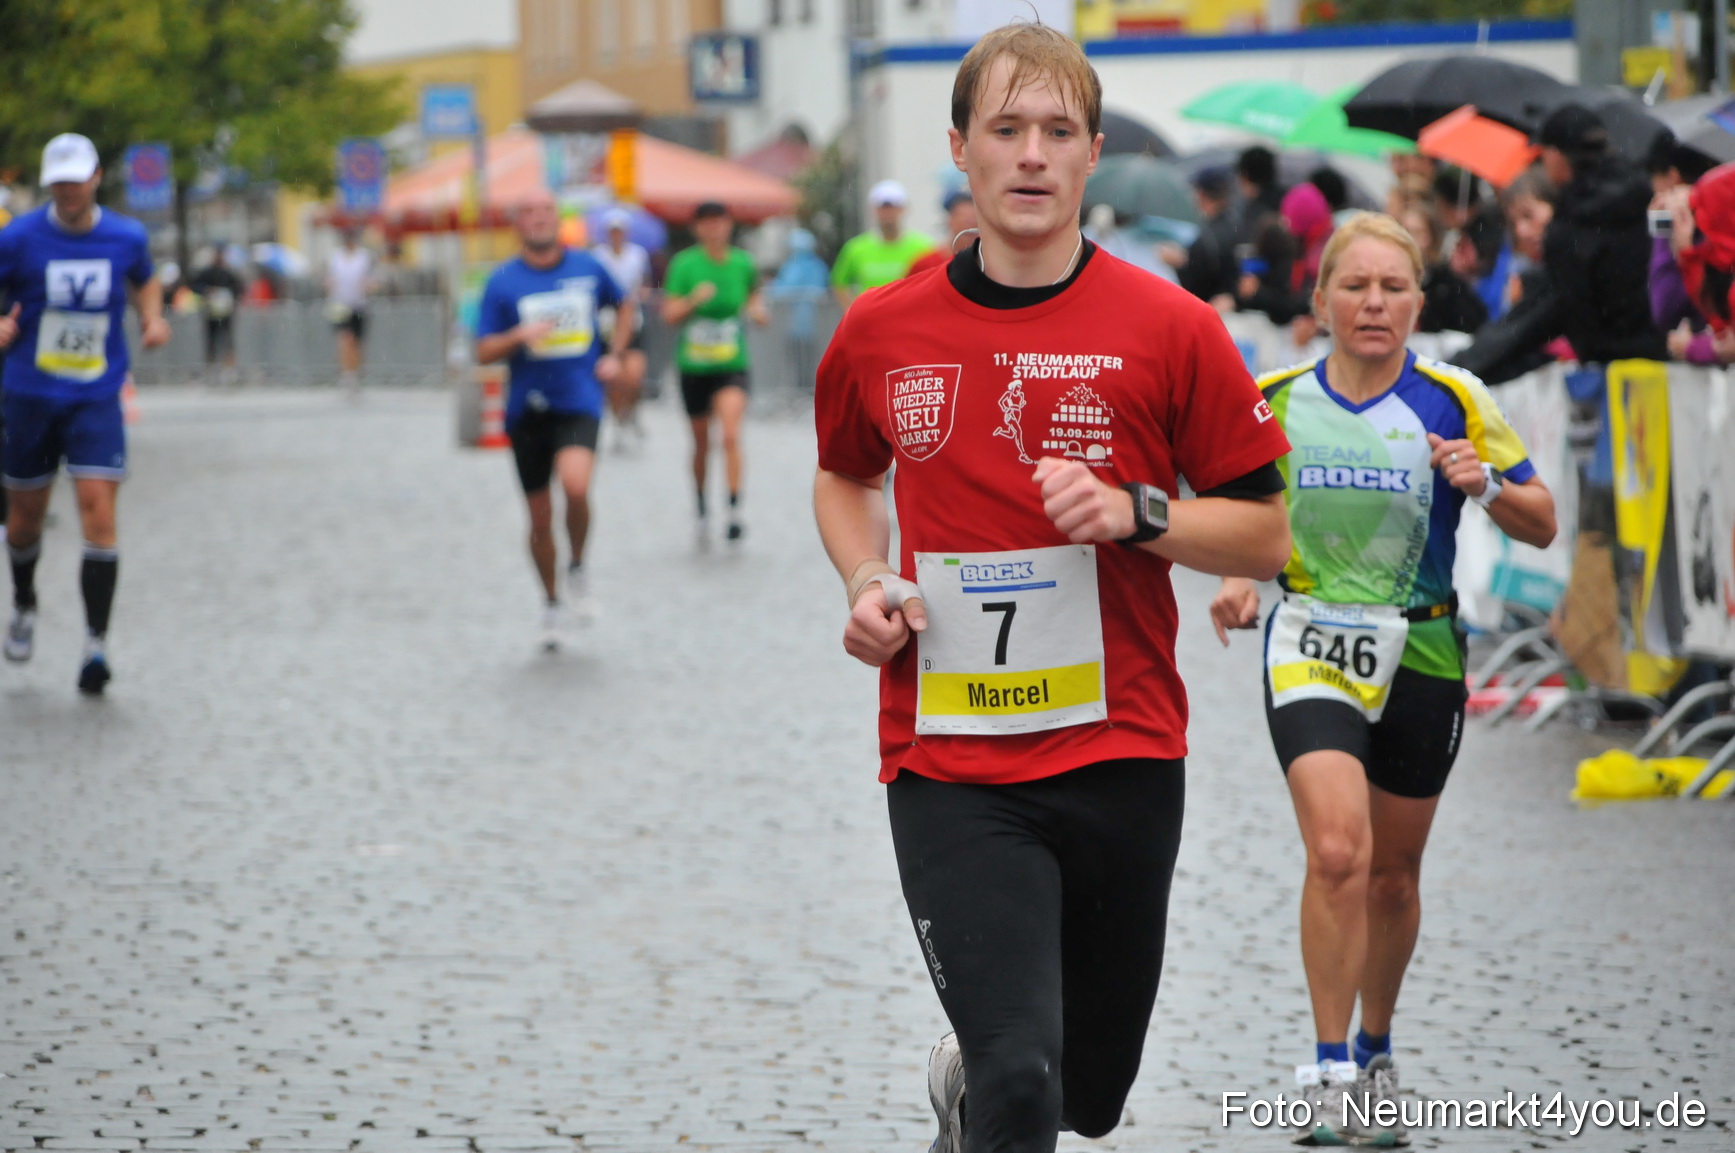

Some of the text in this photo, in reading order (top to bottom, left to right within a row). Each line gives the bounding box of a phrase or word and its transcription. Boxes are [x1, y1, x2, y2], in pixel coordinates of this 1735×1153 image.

[993, 352, 1123, 370] 11. NEUMARKTER
[1012, 366, 1100, 379] STADTLAUF
[894, 377, 944, 396] IMMER
[892, 392, 946, 411] WIEDER
[895, 406, 941, 432] NEU
[899, 428, 940, 447] MARKT
[1049, 427, 1112, 440] 19.09.2010
[1301, 445, 1371, 463] TEAM
[1298, 464, 1411, 493] BOCK
[960, 561, 1034, 582] BOCK
[982, 601, 1017, 665] 7
[1300, 625, 1377, 678] 646
[925, 659, 932, 671] D
[967, 678, 1049, 708] Marcel
[925, 938, 947, 989] odlo
